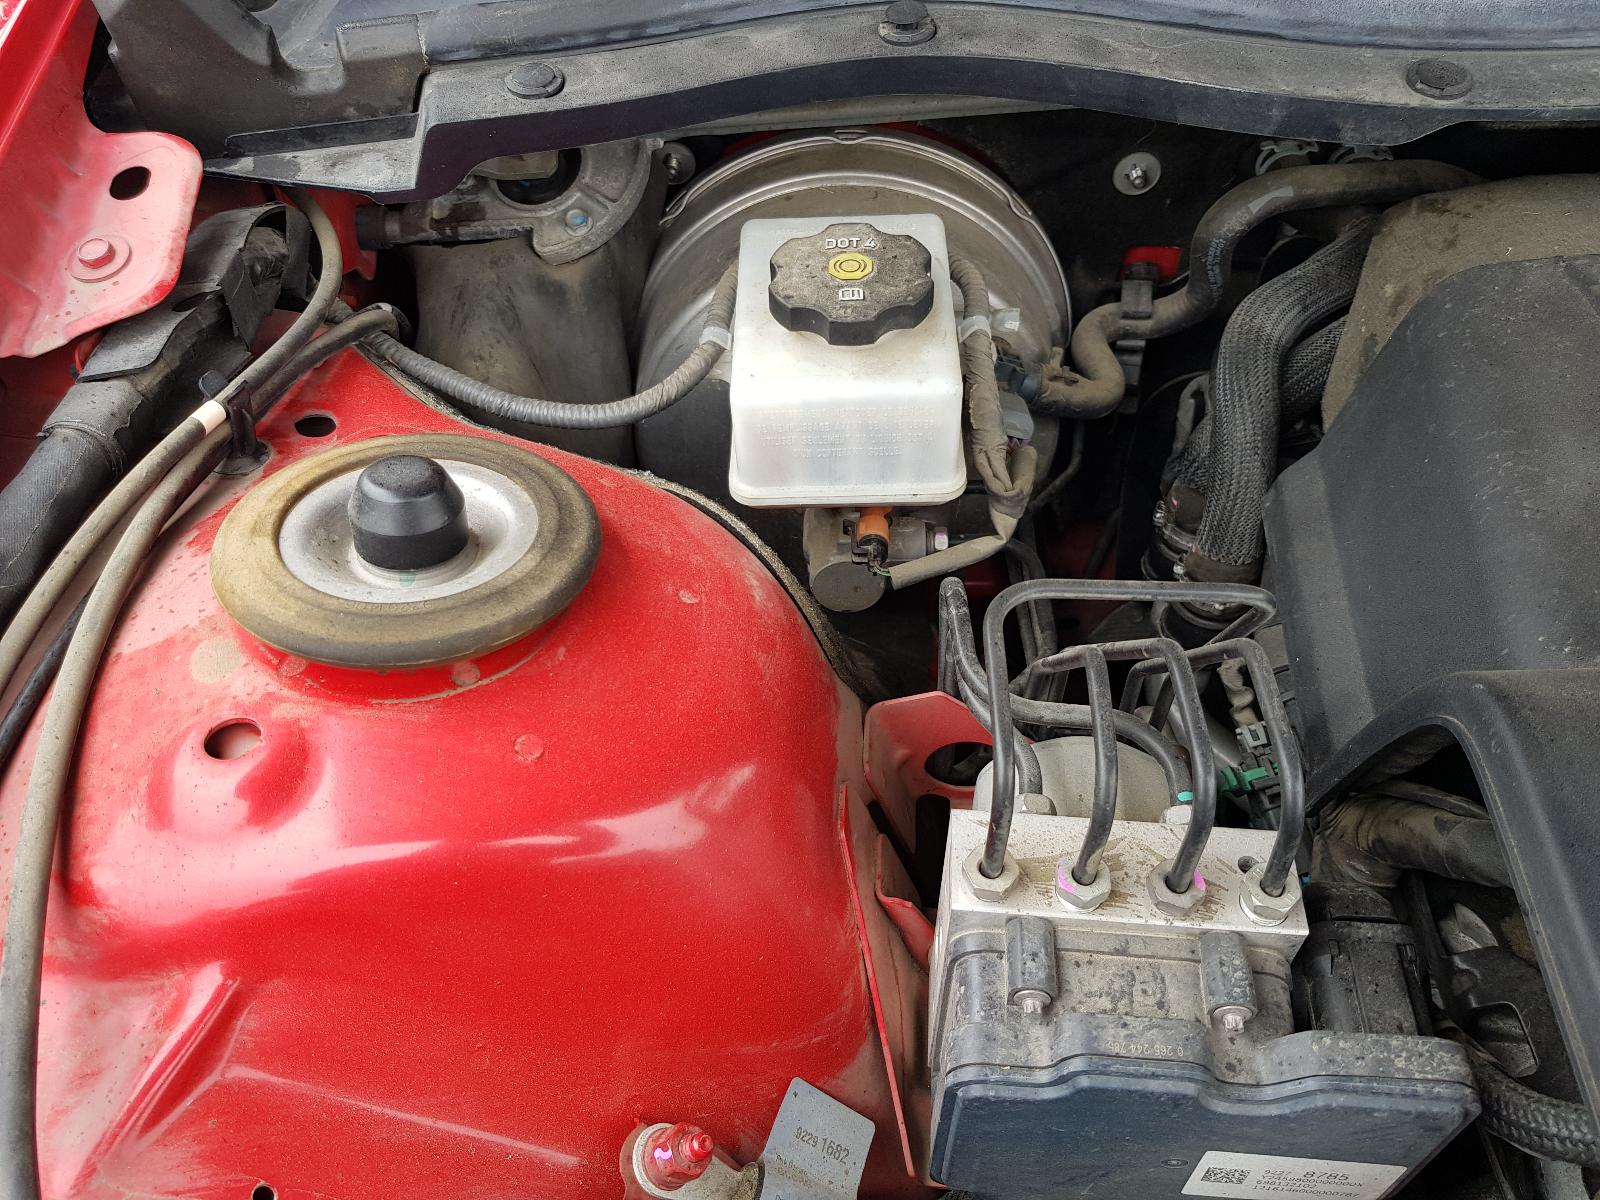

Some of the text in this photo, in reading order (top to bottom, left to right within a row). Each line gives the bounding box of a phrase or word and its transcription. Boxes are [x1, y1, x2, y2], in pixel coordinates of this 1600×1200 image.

[824, 237, 878, 249] DOT 4
[1154, 1044, 1174, 1056] 265
[821, 1137, 850, 1166] 1682
[1303, 1170, 1350, 1181] 8785
